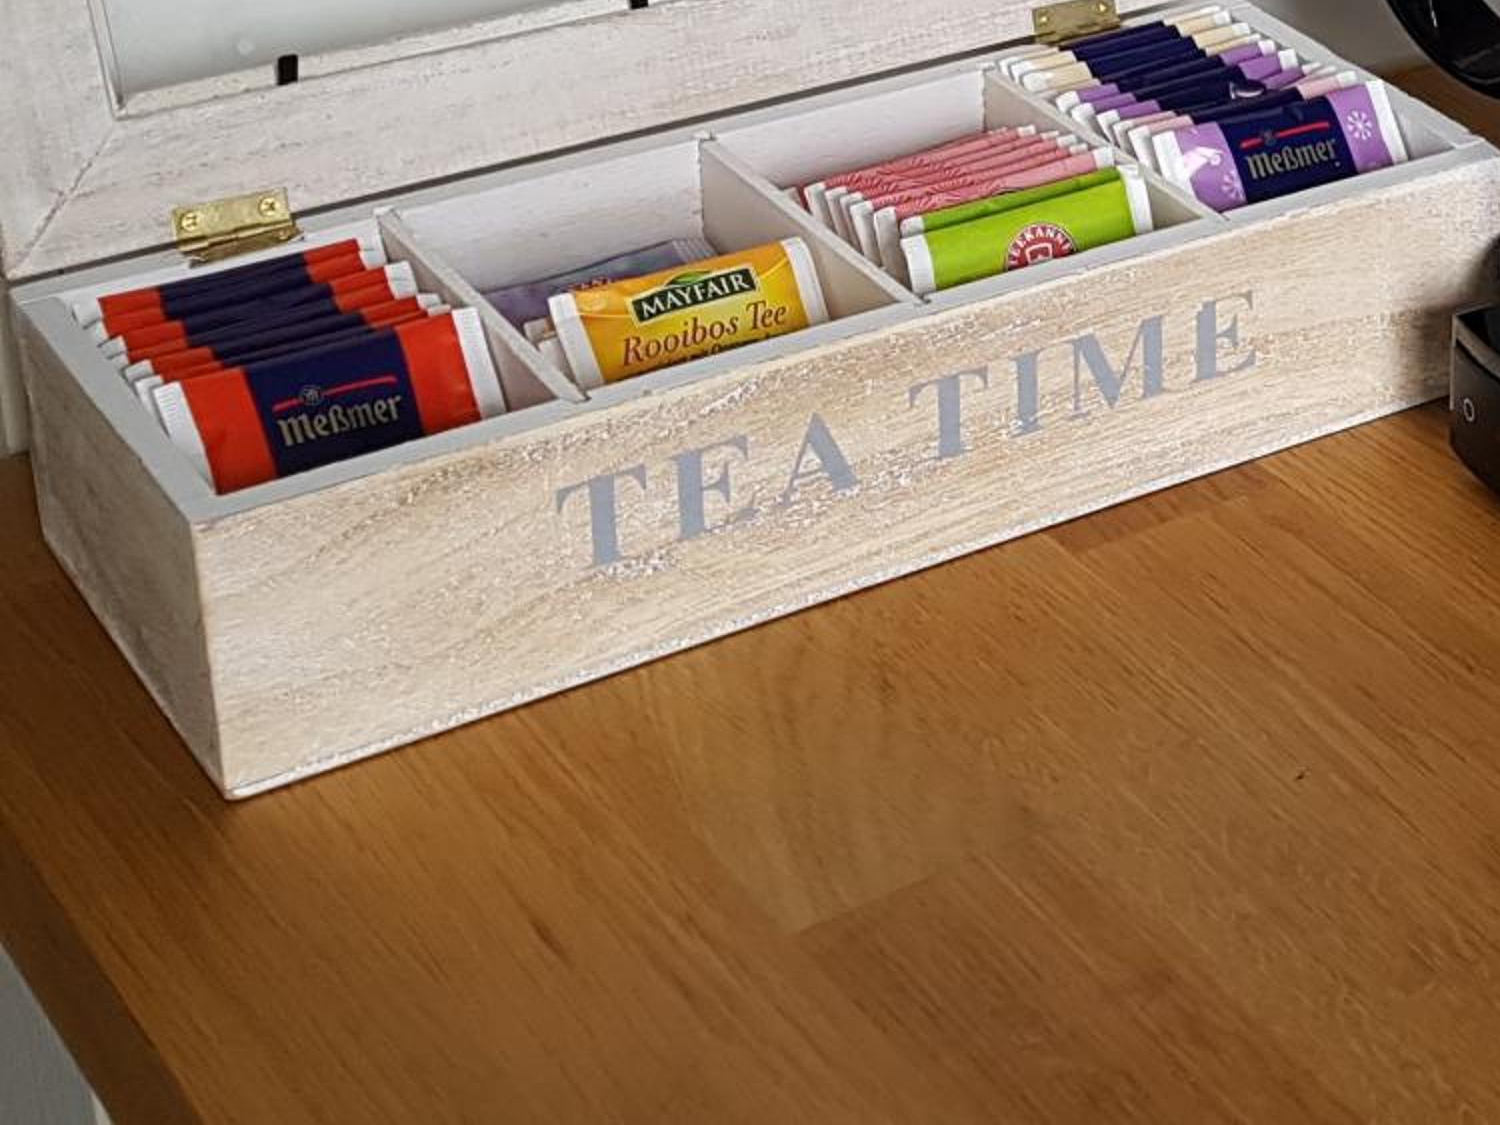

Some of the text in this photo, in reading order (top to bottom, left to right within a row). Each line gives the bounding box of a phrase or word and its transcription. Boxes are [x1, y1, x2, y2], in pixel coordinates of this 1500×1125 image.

[1246, 138, 1336, 180] Meßmer
[641, 272, 751, 319] MAYFAIR
[622, 315, 739, 366] Rooibos
[746, 300, 787, 330] Tee
[277, 393, 402, 447] Meßmer
[556, 289, 1258, 569] TEA TIME
